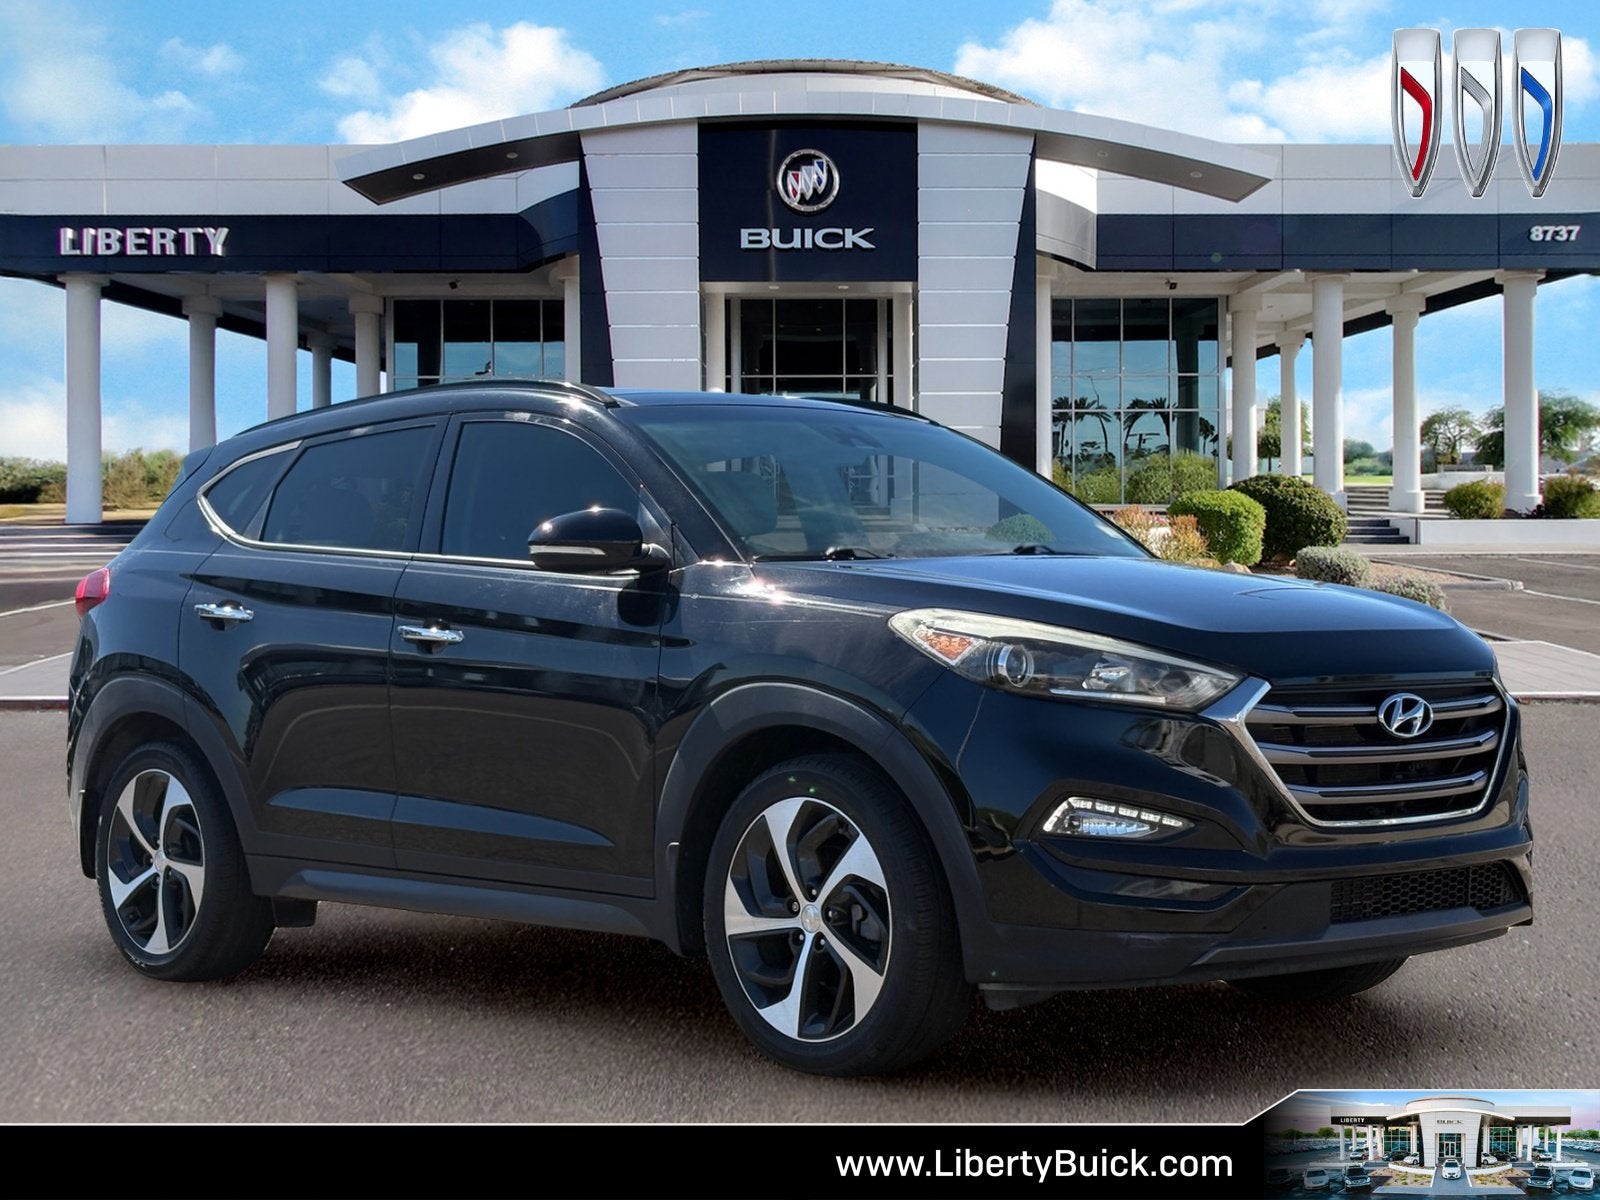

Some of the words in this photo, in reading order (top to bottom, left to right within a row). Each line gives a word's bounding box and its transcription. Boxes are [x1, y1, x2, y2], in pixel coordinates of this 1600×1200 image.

[59, 227, 229, 256] LIBERTY
[740, 228, 876, 249] BUICK
[1529, 225, 1581, 241] 8737
